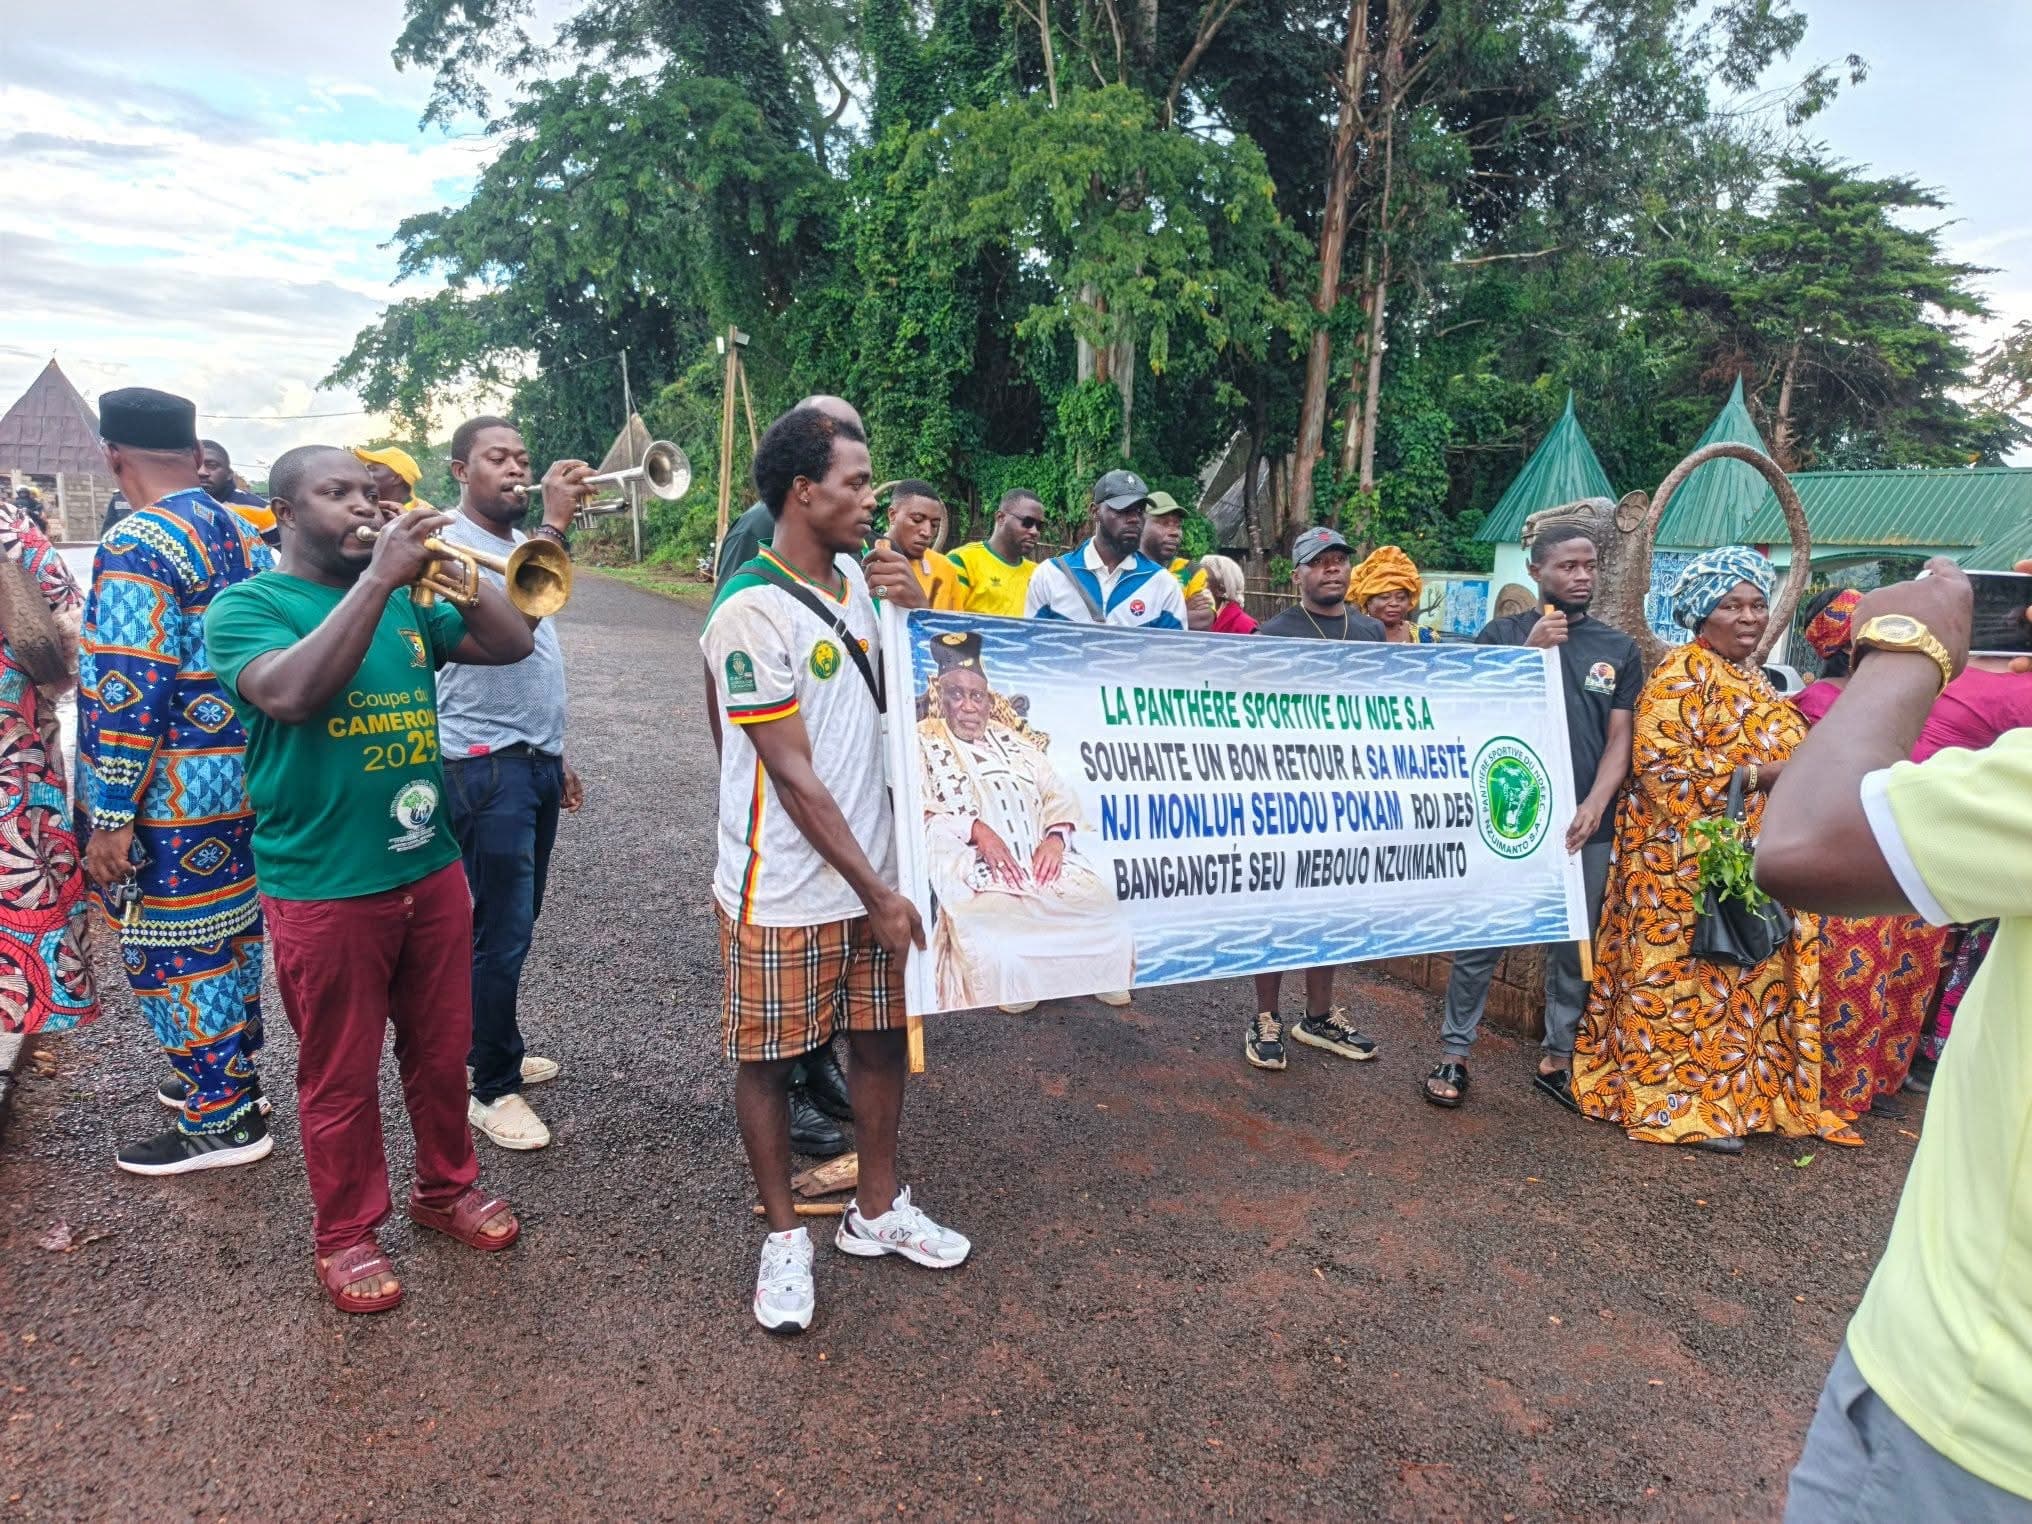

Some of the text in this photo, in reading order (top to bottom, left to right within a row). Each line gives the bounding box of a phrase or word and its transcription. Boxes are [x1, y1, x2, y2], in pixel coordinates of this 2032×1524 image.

[348, 691, 411, 709] Coupe
[1101, 686, 1133, 726] LA
[1243, 692, 1335, 729] SPORTIVE
[1336, 694, 1362, 730] DU
[1365, 695, 1403, 730] NDE
[1404, 696, 1435, 731] S.A
[1080, 736, 1470, 782] SOUHAITE UN BON RETOUR A SA MAJESTÉ
[1100, 790, 1474, 841] NJI MONLUH SEIDOU POKAM ROI DES
[1113, 841, 1467, 901] BANGANGTÉ SEU MEBOUO NZUIMANTO
